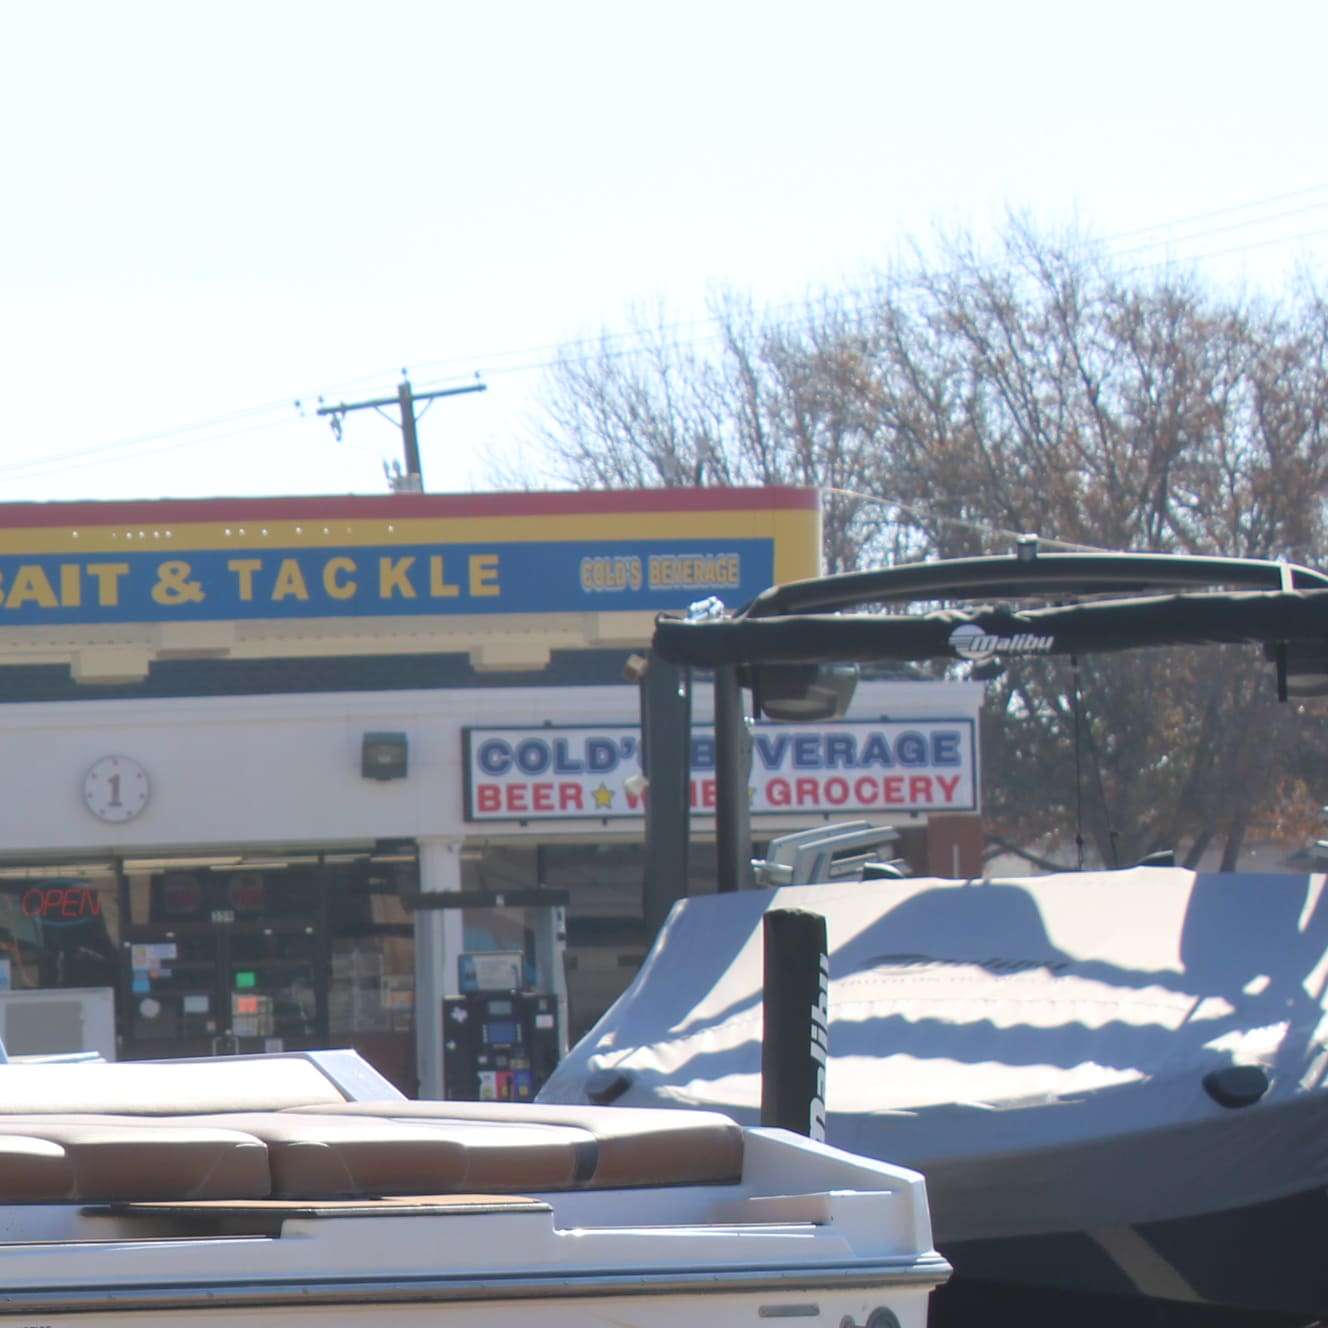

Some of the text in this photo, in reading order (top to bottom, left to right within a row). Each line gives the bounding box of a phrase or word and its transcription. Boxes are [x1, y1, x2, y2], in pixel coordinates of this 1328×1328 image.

[151, 560, 206, 605] &
[228, 554, 501, 602] TACKLE
[477, 730, 962, 777] COLD' BVERAGE
[107, 773, 123, 807] 1
[477, 774, 961, 813] BEER GROCERY
[20, 888, 101, 917] OPEN
